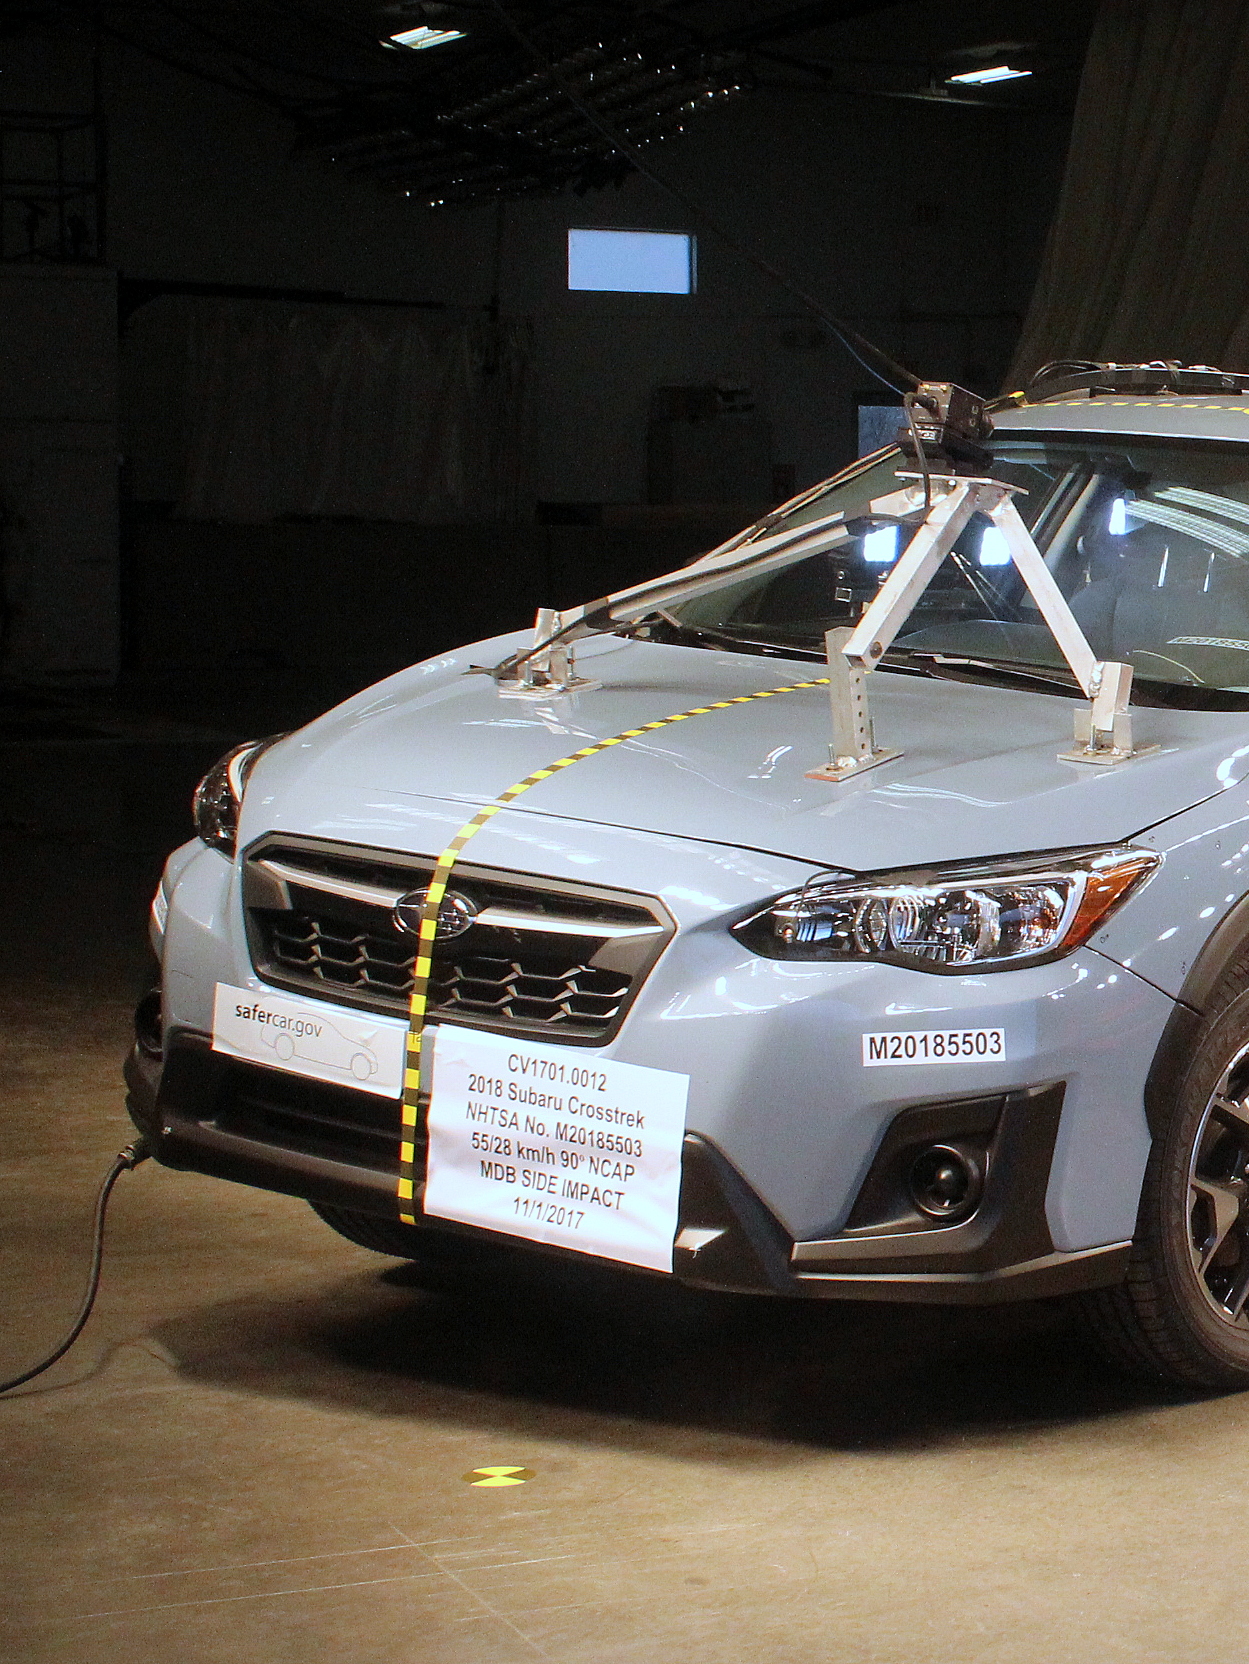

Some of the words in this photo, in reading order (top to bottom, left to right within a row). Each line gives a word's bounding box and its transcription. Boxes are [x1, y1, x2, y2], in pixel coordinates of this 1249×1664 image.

[235, 1003, 324, 1038] safercar.gov
[869, 1031, 1002, 1060] M20185503
[507, 1053, 608, 1092] CV1701.0012
[468, 1073, 503, 1098] 2018
[508, 1082, 563, 1112] Subaru
[568, 1096, 645, 1130] Crosstrek
[466, 1101, 520, 1131] NHTSA
[524, 1115, 550, 1138] No.
[555, 1121, 643, 1158] M20185503
[471, 1131, 512, 1157] 55/28
[517, 1140, 556, 1166] km/h
[588, 1155, 636, 1183] NCAP
[480, 1160, 517, 1185] MDB
[522, 1169, 559, 1195] SIDE
[561, 1179, 626, 1210] IMPACT
[512, 1196, 585, 1230] 11/1/2017
